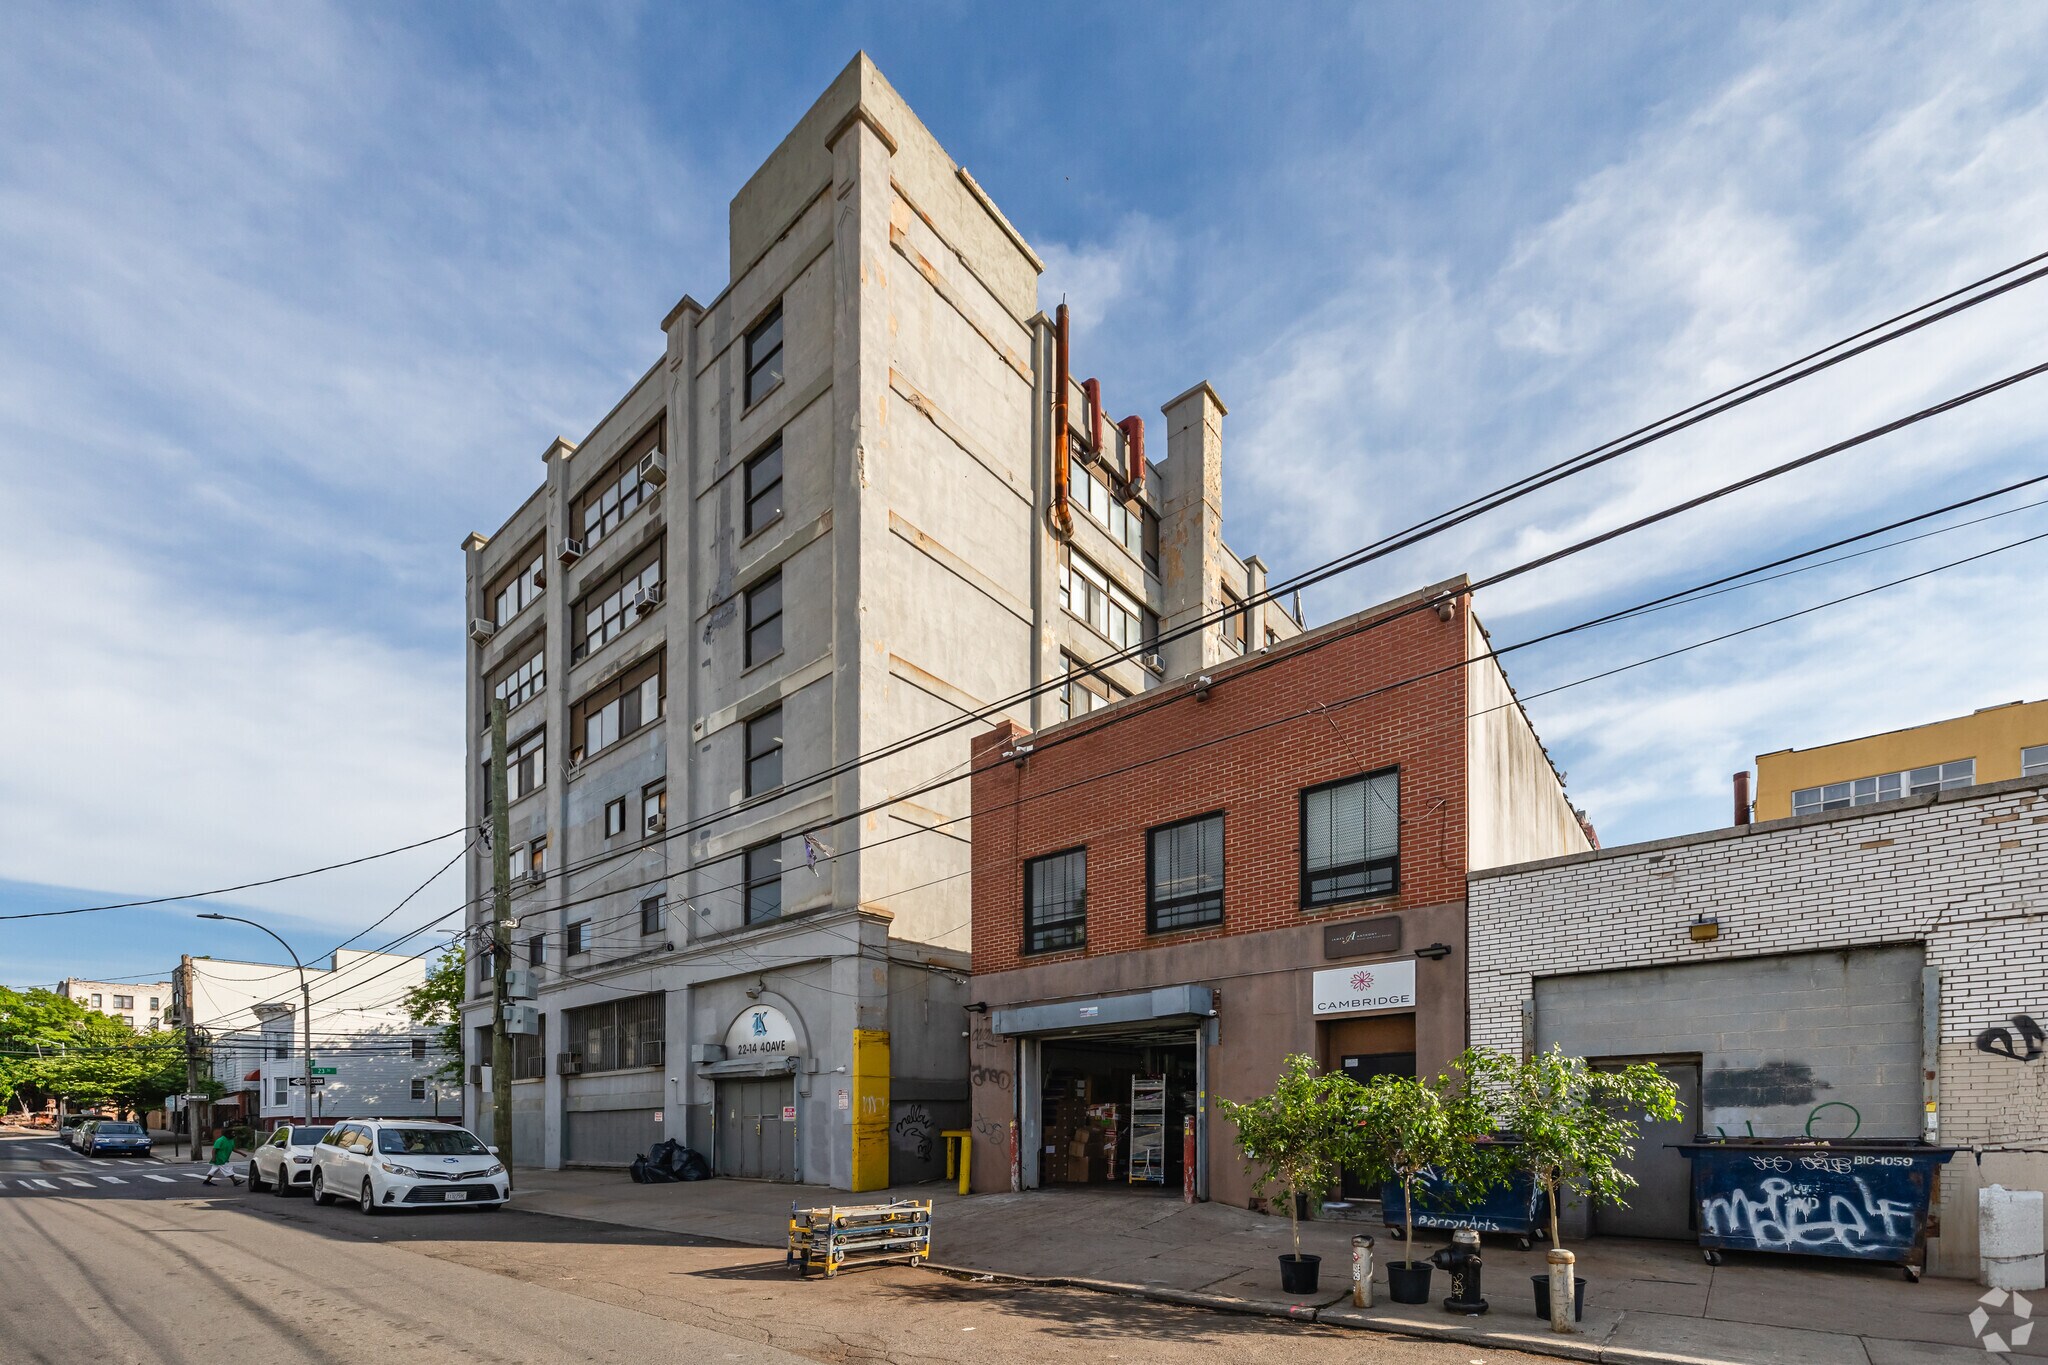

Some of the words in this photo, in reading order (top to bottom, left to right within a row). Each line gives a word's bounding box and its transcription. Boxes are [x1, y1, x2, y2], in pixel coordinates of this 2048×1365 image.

[1317, 994, 1410, 1011] CAMBRIDGE
[738, 1043, 758, 1056] 22-14
[1854, 1155, 1913, 1167] BIC-1059
